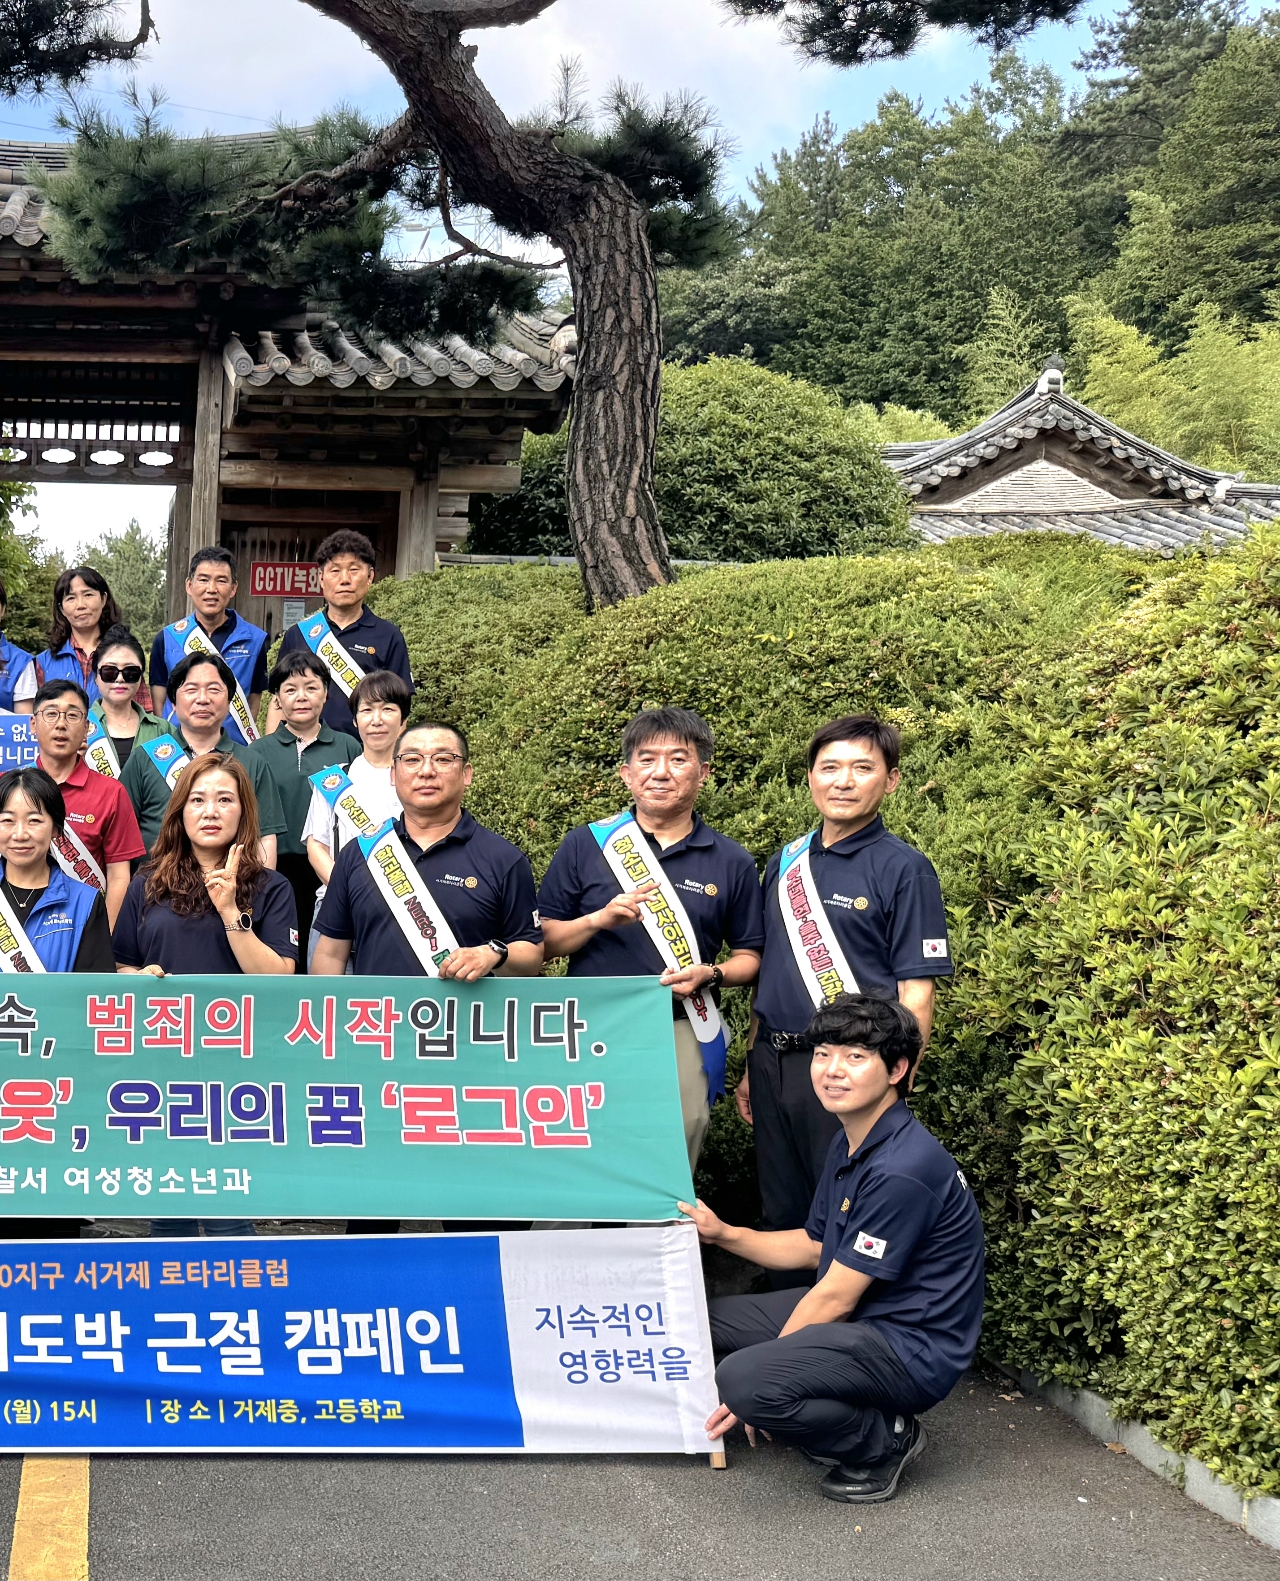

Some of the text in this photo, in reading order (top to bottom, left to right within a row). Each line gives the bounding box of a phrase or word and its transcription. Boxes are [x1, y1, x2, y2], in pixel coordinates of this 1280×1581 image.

[374, 844, 415, 899] 학교폭력
[612, 834, 651, 883] 청소년
[85, 993, 254, 1058] 범죄의
[284, 994, 607, 1062] 시작입니다.
[106, 1080, 287, 1146] 우리의
[305, 1083, 366, 1148] 꿈
[62, 1165, 251, 1195] 여성청소년과
[75, 1260, 151, 1290] 서거제
[159, 1258, 290, 1289] 로타리클럽
[146, 1310, 266, 1377] 근절
[284, 1306, 465, 1376] 캠페인
[535, 1302, 665, 1340] 지속적인
[558, 1347, 693, 1385] 영향력을
[4, 1399, 41, 1425] (월)
[50, 1399, 98, 1424] 15시
[233, 1399, 308, 1424] 거제중,
[313, 1398, 405, 1424] 고등학교
